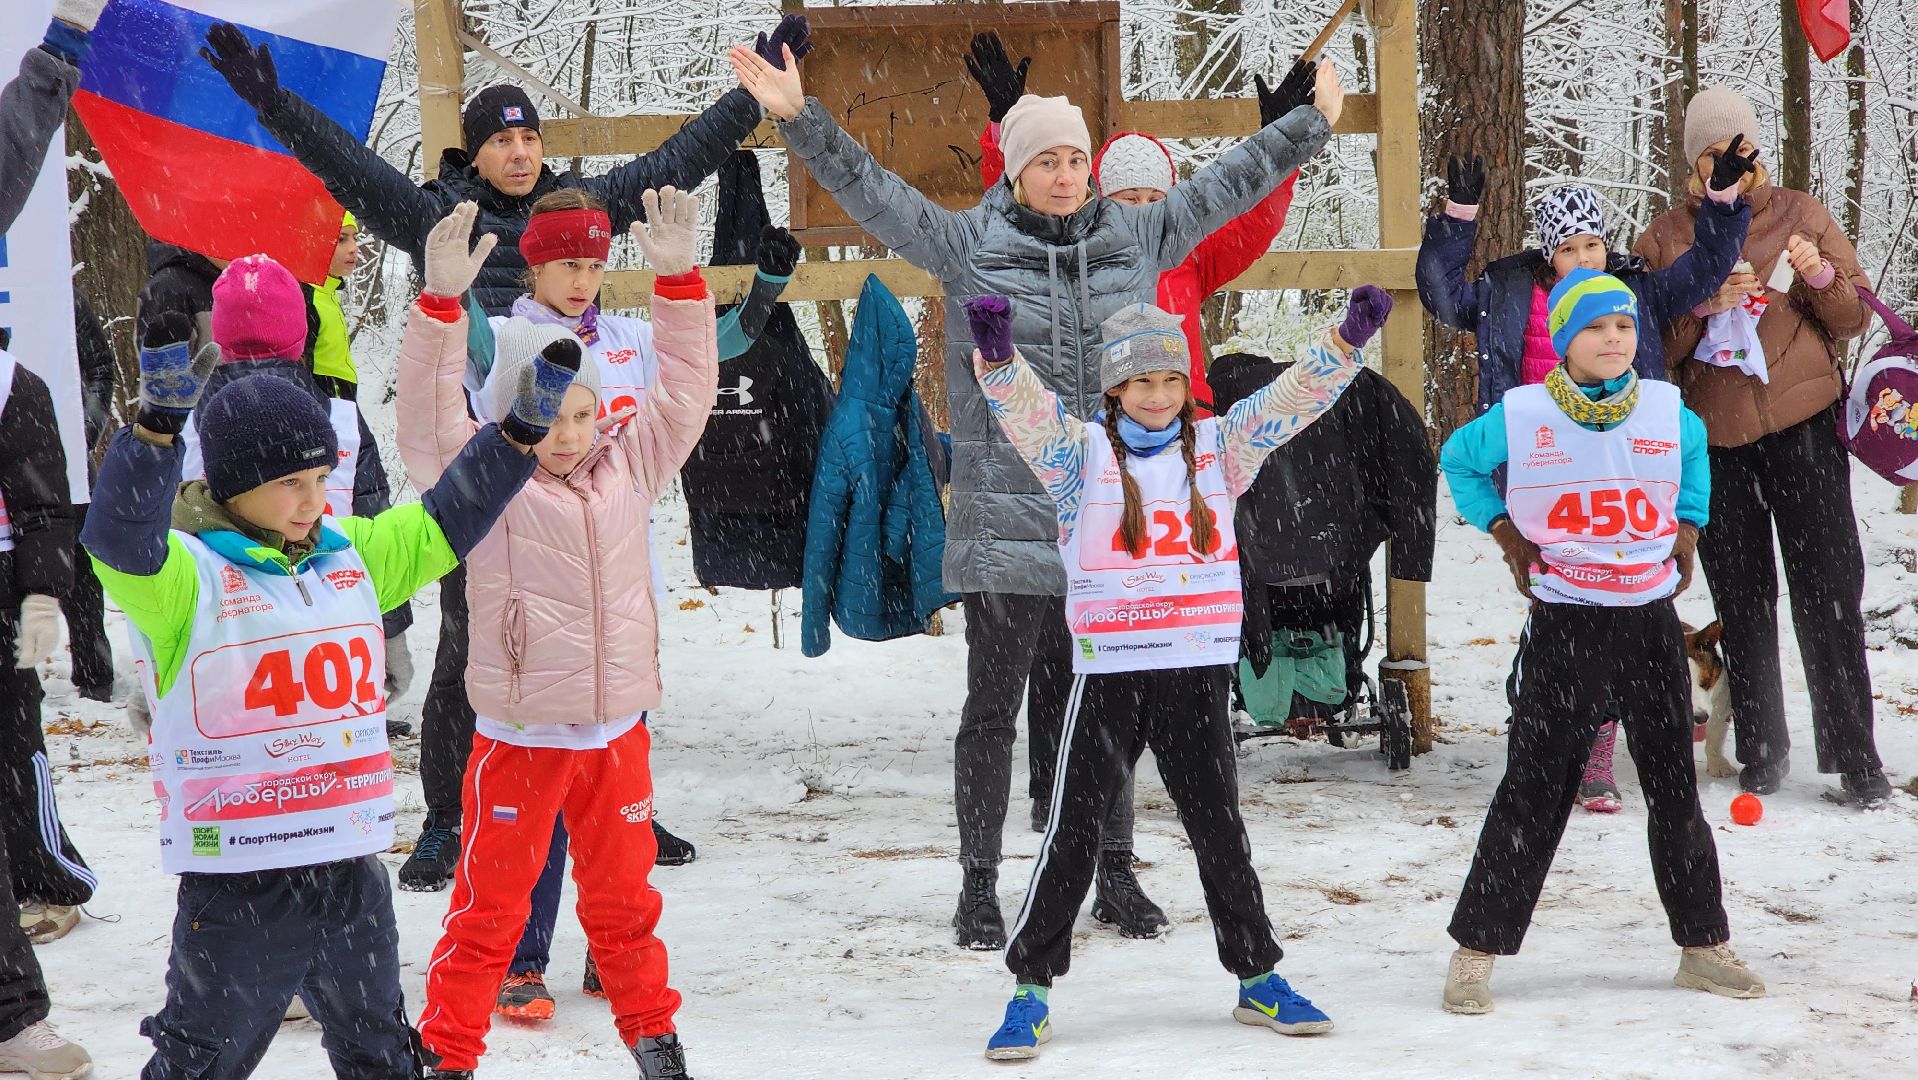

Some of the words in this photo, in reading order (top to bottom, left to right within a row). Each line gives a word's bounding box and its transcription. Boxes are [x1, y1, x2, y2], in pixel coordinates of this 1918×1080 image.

[1633, 438, 1678, 449] МОСОБЛ
[1529, 450, 1564, 459] Команда
[1632, 446, 1669, 456] СПОРТ
[1522, 457, 1573, 468] губернатора
[1547, 487, 1659, 537] 450
[1074, 605, 1174, 628] Люберцы
[245, 636, 377, 717] 402
[299, 732, 322, 744] Way
[191, 754, 240, 764] ПрофиМосква
[288, 754, 311, 763] HOTEL
[263, 774, 312, 788] городской
[314, 771, 337, 782] округ
[187, 778, 337, 814] Люберцы
[239, 826, 334, 845] СпортНормаЖизни
